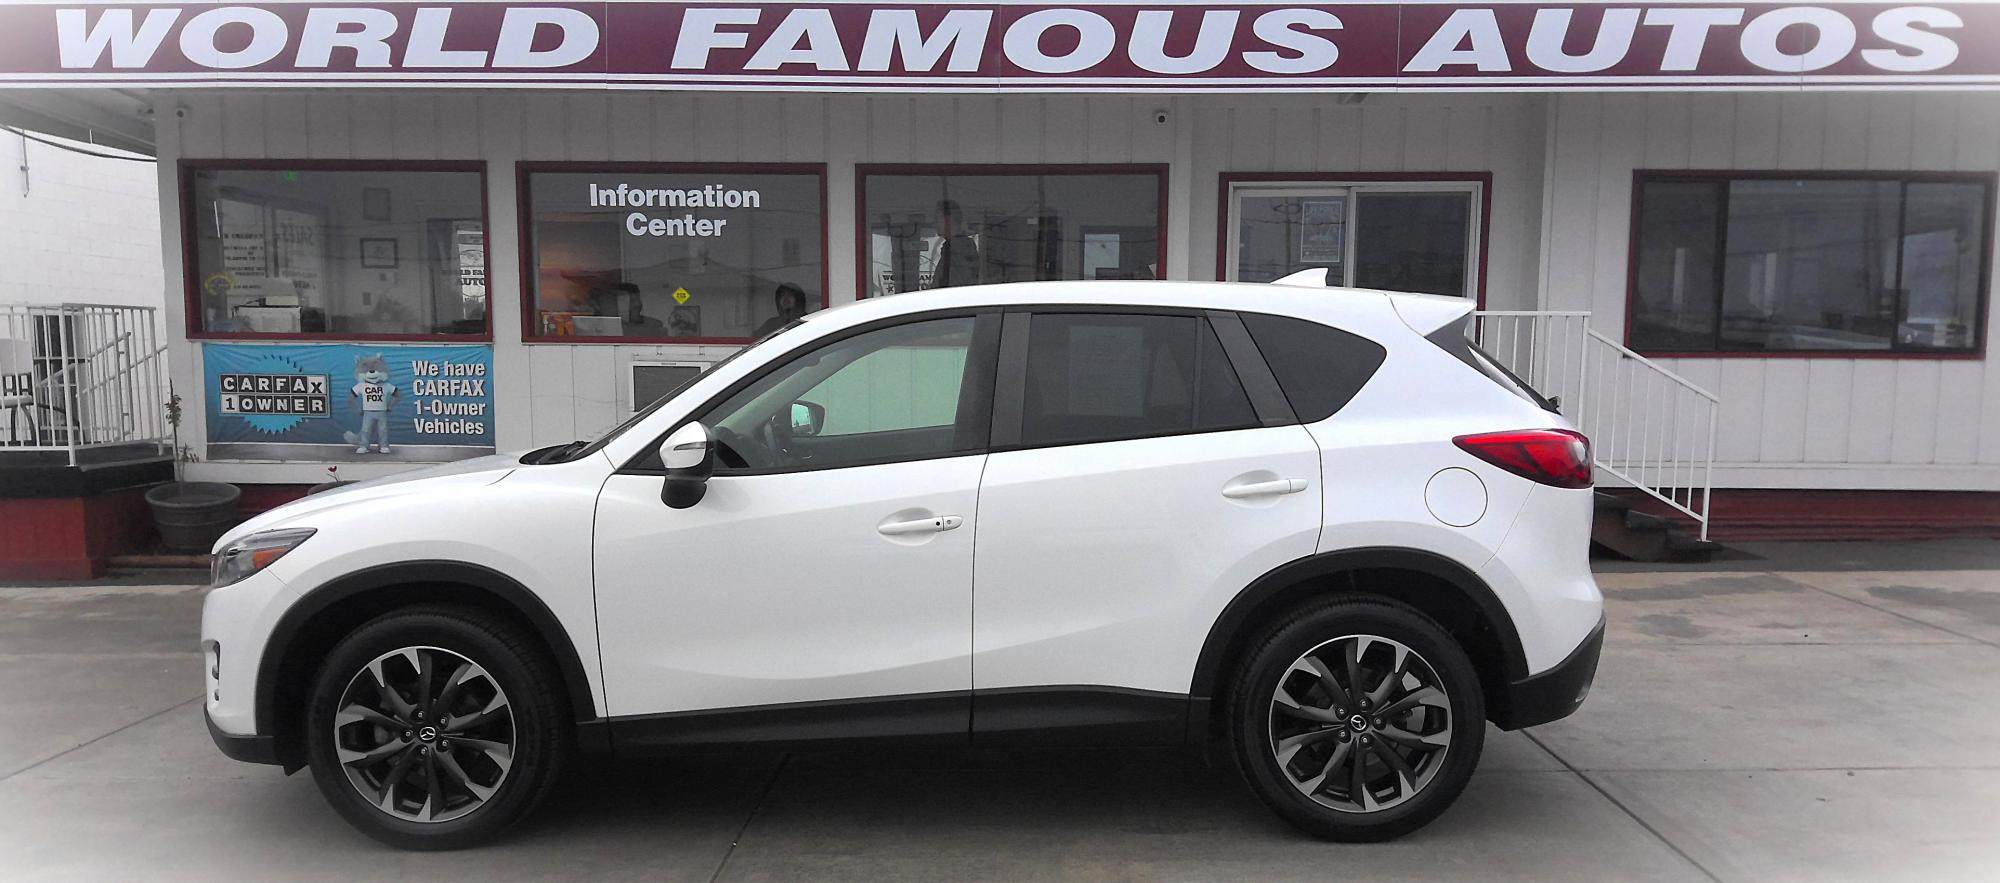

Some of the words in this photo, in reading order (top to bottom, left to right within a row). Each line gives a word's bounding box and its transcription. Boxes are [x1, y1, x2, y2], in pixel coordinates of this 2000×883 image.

[55, 6, 600, 69] WORLD
[670, 7, 1344, 74] FAMOUS
[1401, 6, 1965, 73] AUTOS
[588, 183, 761, 208] Information
[625, 212, 727, 237] Center
[412, 360, 439, 376] We
[443, 360, 486, 376] have
[222, 377, 323, 394] CARFAX
[364, 386, 384, 395] CAR
[412, 379, 486, 396] CARFAX
[241, 398, 324, 412] OWNER
[366, 394, 384, 403] FOX
[413, 399, 486, 416] 1-Owner
[413, 418, 485, 435] Vehicles
